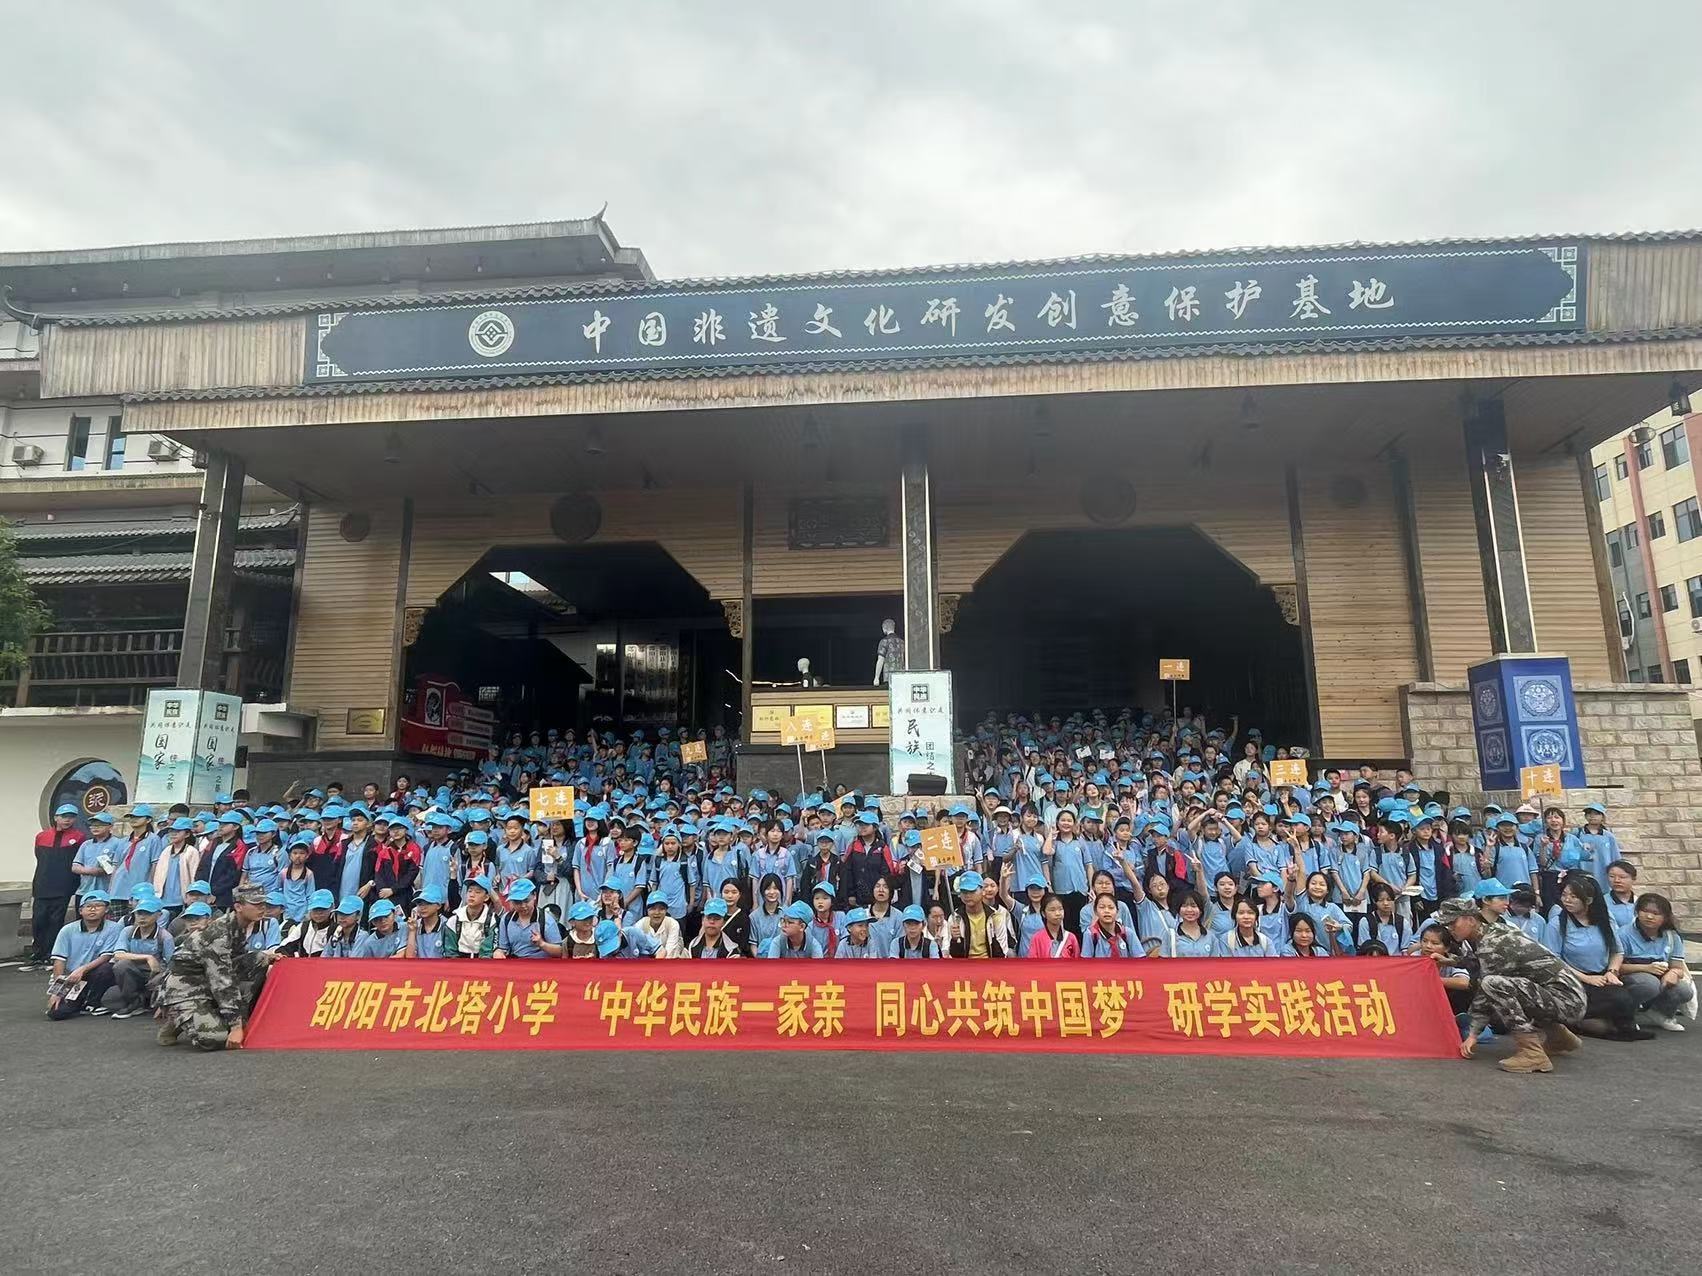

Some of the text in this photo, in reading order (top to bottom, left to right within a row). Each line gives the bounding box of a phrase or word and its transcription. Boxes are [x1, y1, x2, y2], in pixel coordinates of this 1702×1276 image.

[582, 274, 1395, 354] 中国非遗文化研发创意保护基地
[155, 734, 169, 770] 国家
[206, 736, 218, 771] 国家
[905, 719, 923, 757] 民族
[536, 789, 568, 806] 七连
[926, 829, 953, 851] 二连
[311, 980, 1396, 1037] 邵阳市北塔小学 “中华民族一家亲 同心共筑中国梦” 研学实践活动
